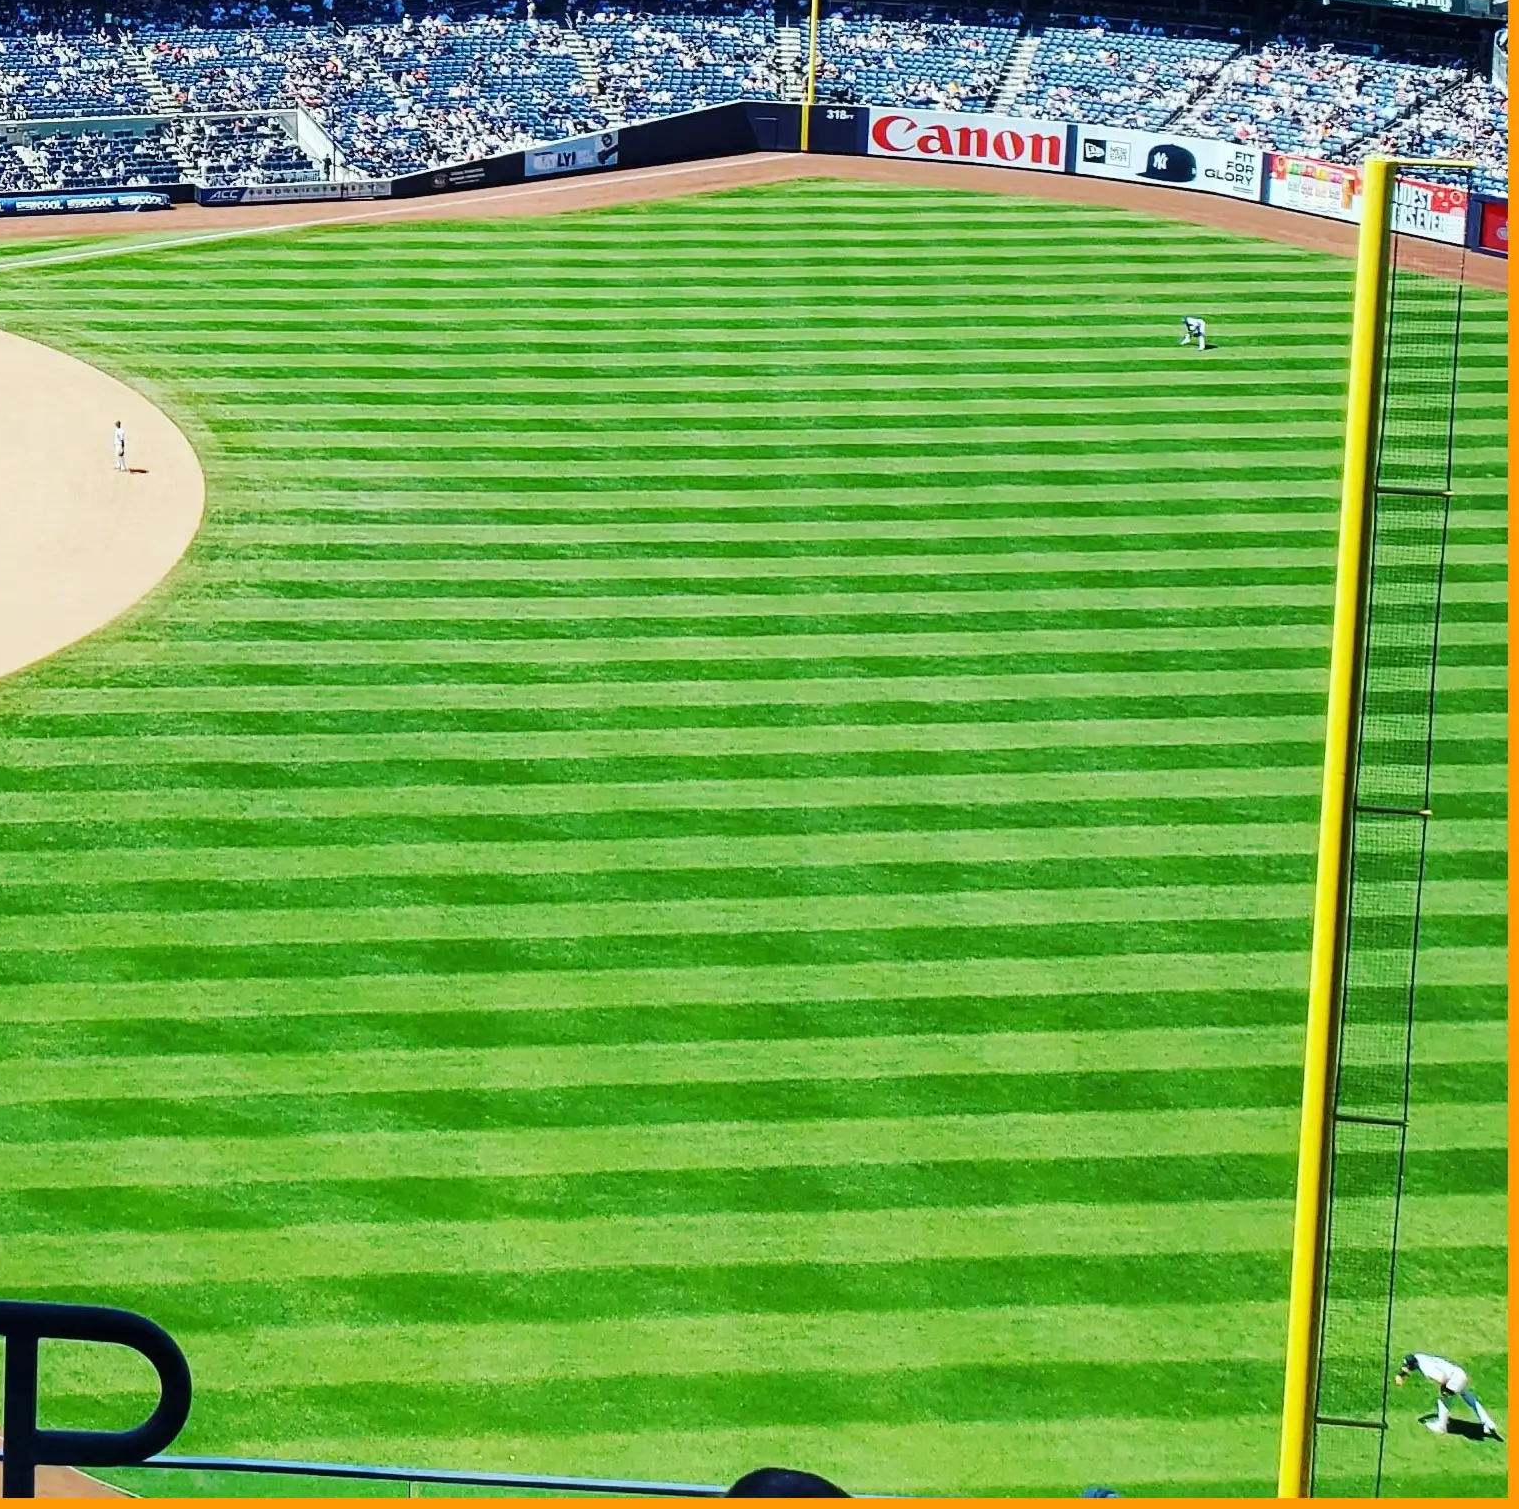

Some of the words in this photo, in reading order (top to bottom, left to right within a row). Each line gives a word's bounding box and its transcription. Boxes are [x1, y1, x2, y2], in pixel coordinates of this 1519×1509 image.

[872, 115, 1060, 165] Canon
[1235, 151, 1255, 162] FIT
[1227, 161, 1255, 173] FOR
[1204, 168, 1254, 185] GLORY
[210, 190, 239, 199] ACC
